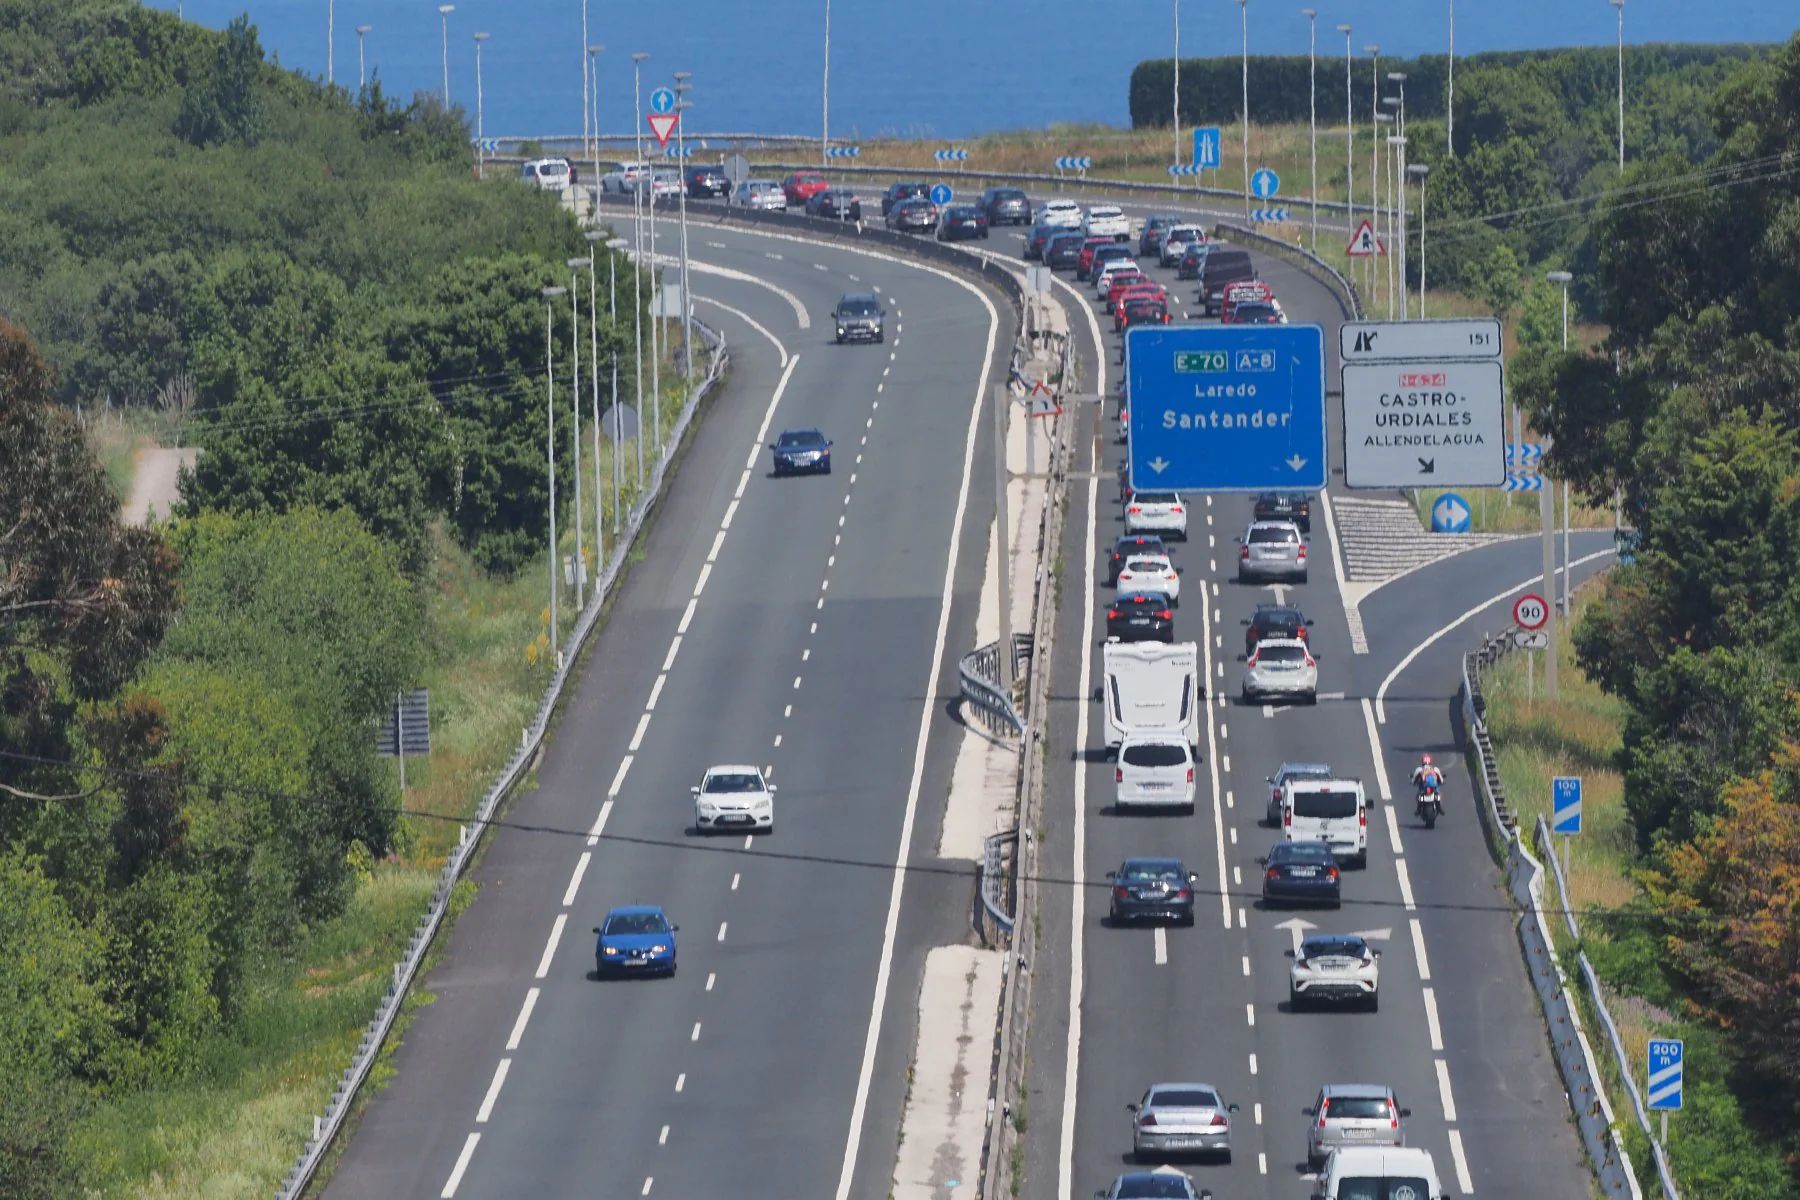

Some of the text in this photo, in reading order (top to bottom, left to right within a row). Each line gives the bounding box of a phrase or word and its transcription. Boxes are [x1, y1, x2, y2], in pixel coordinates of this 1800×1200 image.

[1469, 333, 1490, 345] 151
[1176, 354, 1225, 370] E-70
[1239, 353, 1273, 369] A-8
[1195, 383, 1257, 397] Laredo
[1380, 392, 1467, 407] CASTRO-
[1162, 409, 1290, 429] Santander
[1376, 412, 1472, 427] URDIALES
[1364, 433, 1484, 447] ALLENDELAGUA
[1521, 606, 1540, 619] 90
[1558, 780, 1576, 791] 100
[1653, 1044, 1679, 1056] 200
[1660, 1056, 1671, 1065] m
